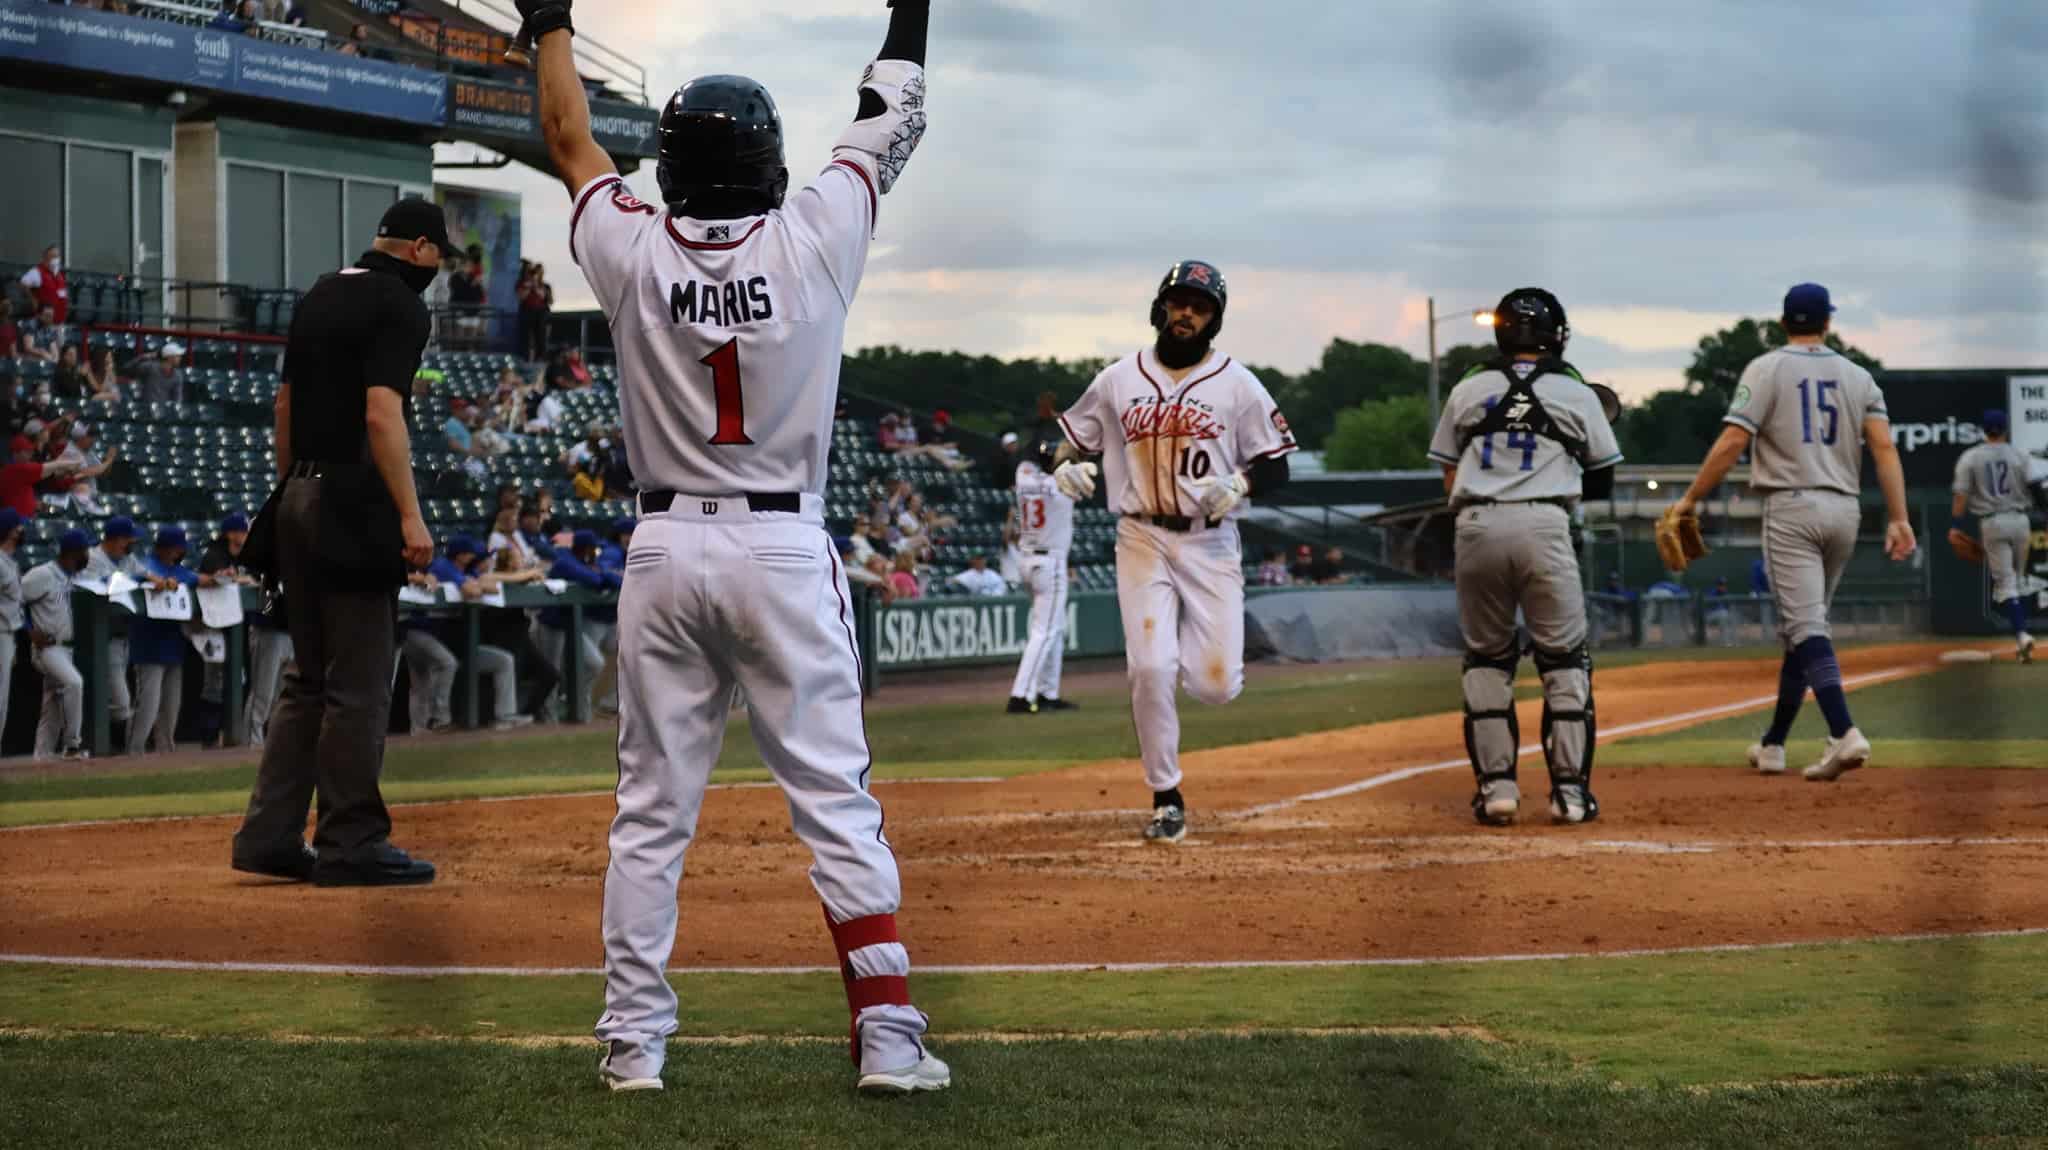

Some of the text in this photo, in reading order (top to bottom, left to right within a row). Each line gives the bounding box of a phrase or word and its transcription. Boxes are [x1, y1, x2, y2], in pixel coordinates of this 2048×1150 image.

[194, 32, 230, 59] South
[455, 83, 533, 114] BRANDITO
[671, 275, 773, 327] MARIS
[698, 336, 755, 446] 1
[2020, 386, 2045, 400] THE
[1797, 377, 1838, 446] 15
[1178, 447, 1211, 480] 10
[1984, 460, 2010, 497] 12
[1020, 497, 1047, 529] 13
